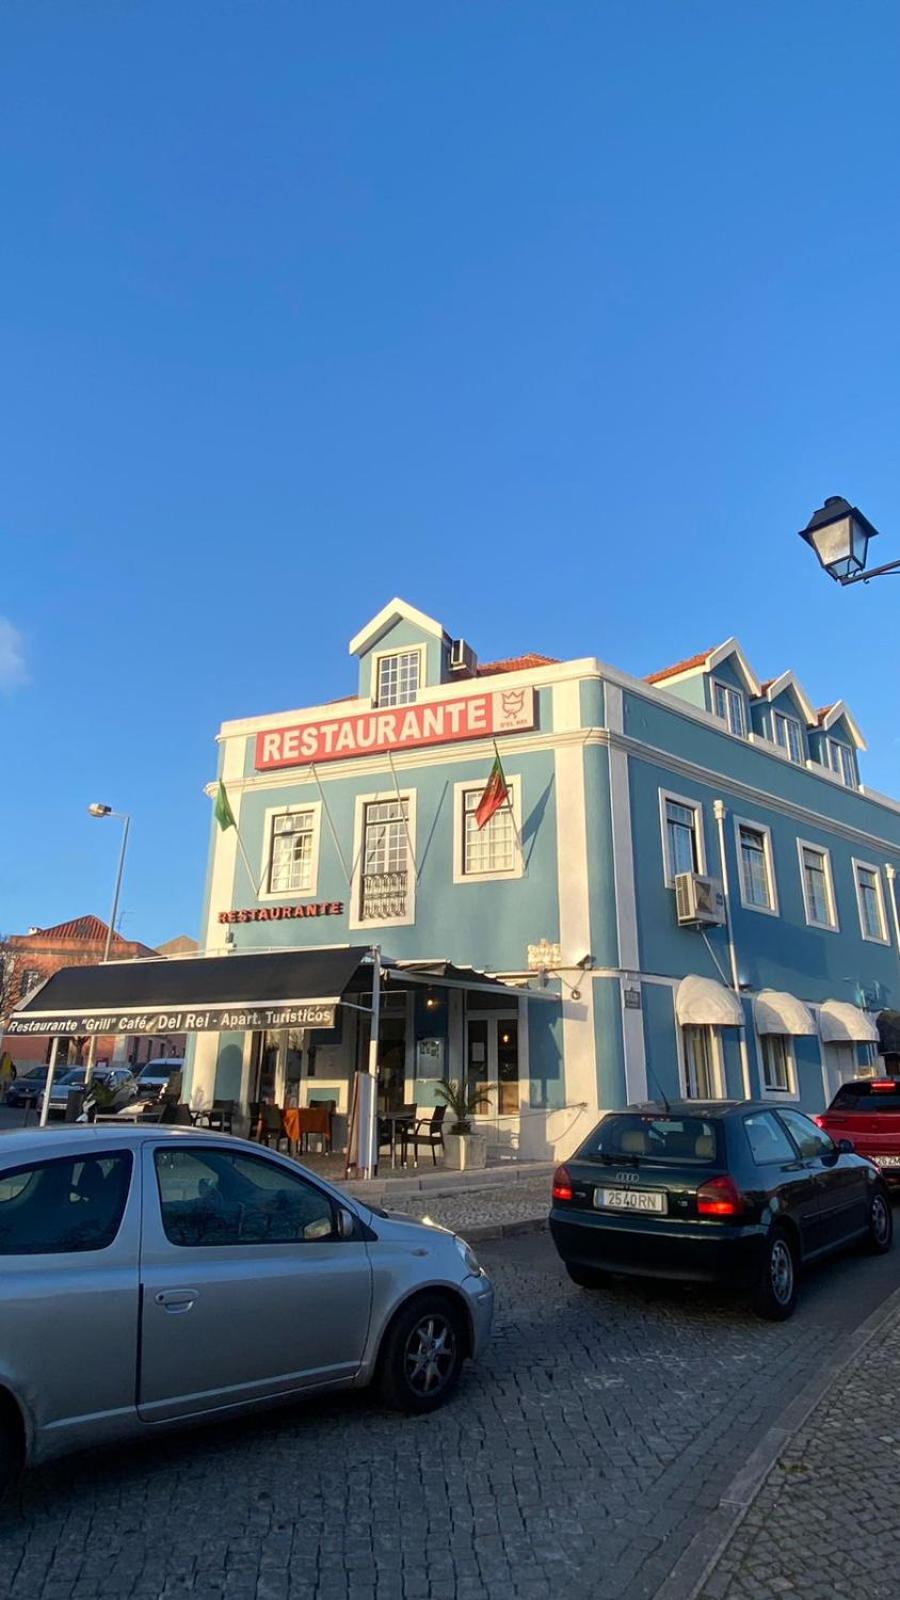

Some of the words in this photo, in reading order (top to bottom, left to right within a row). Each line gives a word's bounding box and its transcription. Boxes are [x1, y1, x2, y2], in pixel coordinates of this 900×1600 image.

[262, 698, 487, 762] RESTAURANTE
[218, 901, 343, 923] RESTAURANTE
[8, 1020, 77, 1032] Restaurante
[81, 1017, 116, 1031] "Grill"
[118, 1015, 146, 1029] Café
[157, 1013, 181, 1030] Del
[185, 1013, 210, 1028] Rei
[220, 1012, 262, 1027] Apart.
